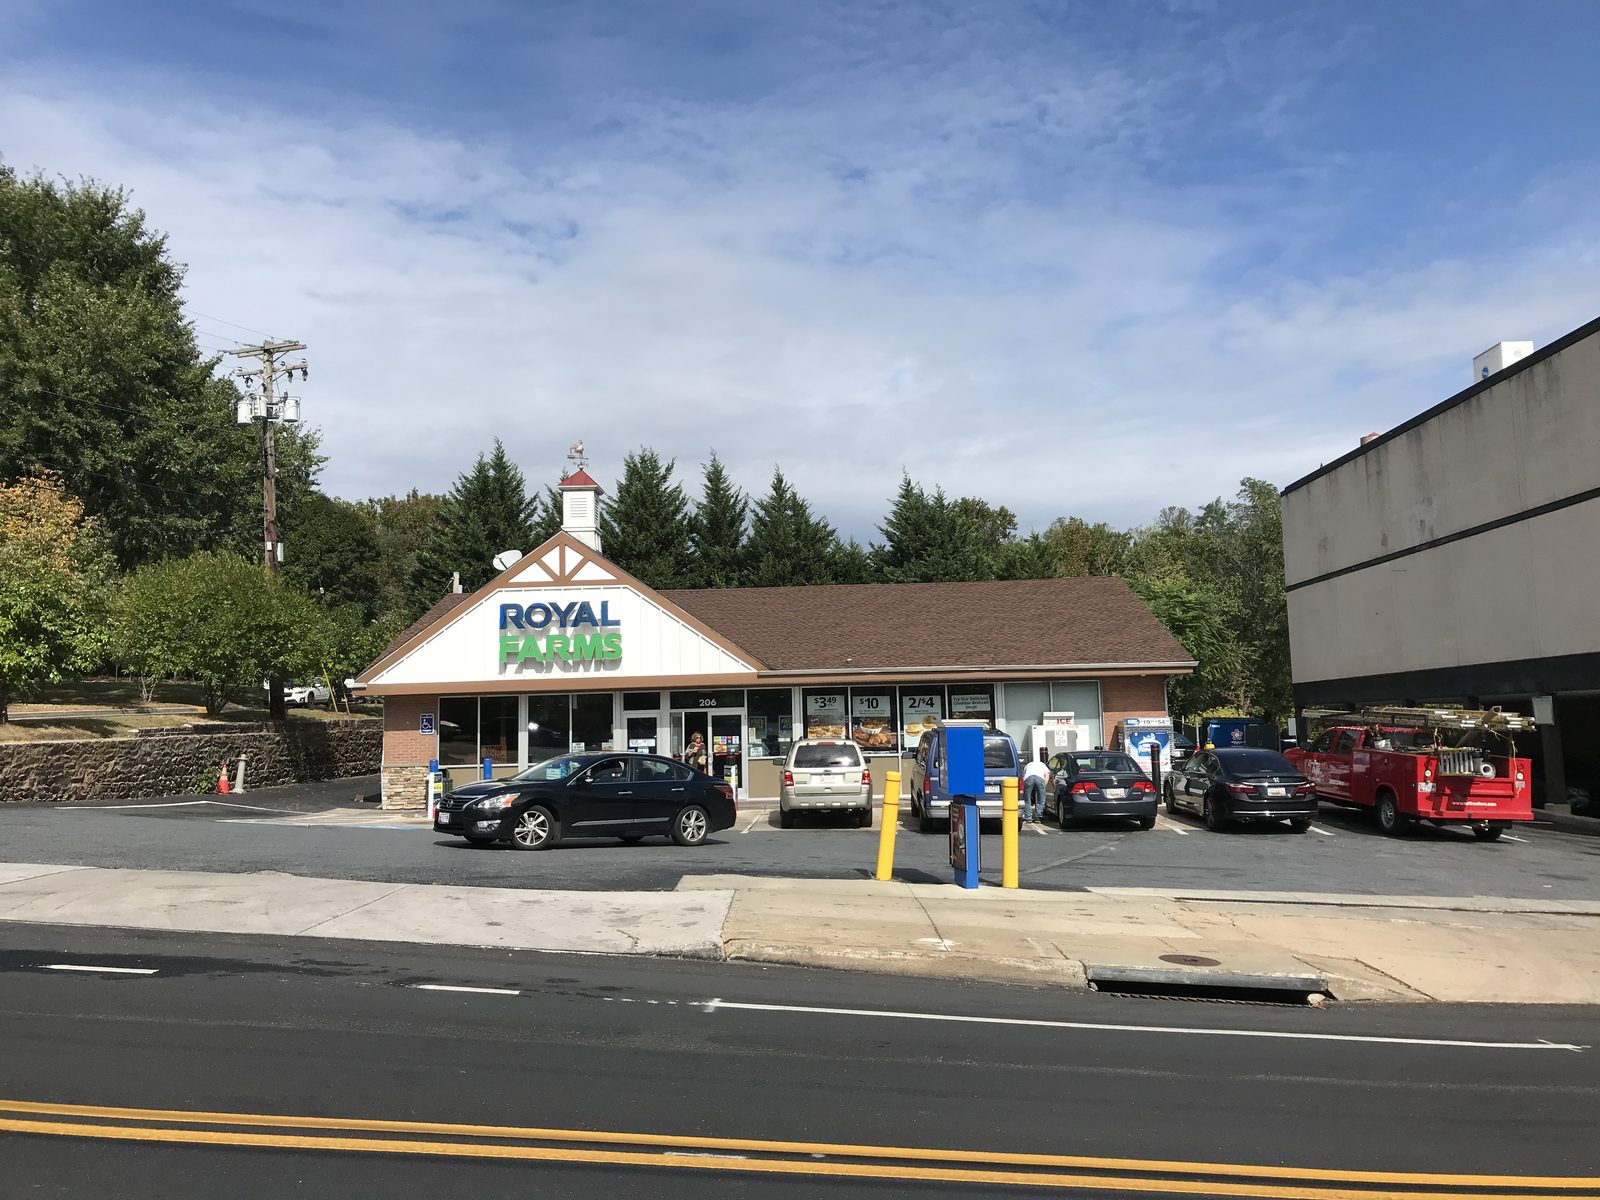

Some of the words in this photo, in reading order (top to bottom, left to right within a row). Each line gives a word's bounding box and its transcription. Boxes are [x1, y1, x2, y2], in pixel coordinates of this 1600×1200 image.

[499, 601, 621, 630] ROYAL
[499, 633, 622, 663] FARMS
[699, 699, 717, 707] 206
[860, 698, 879, 709] $10
[908, 697, 935, 709] 2/$4
